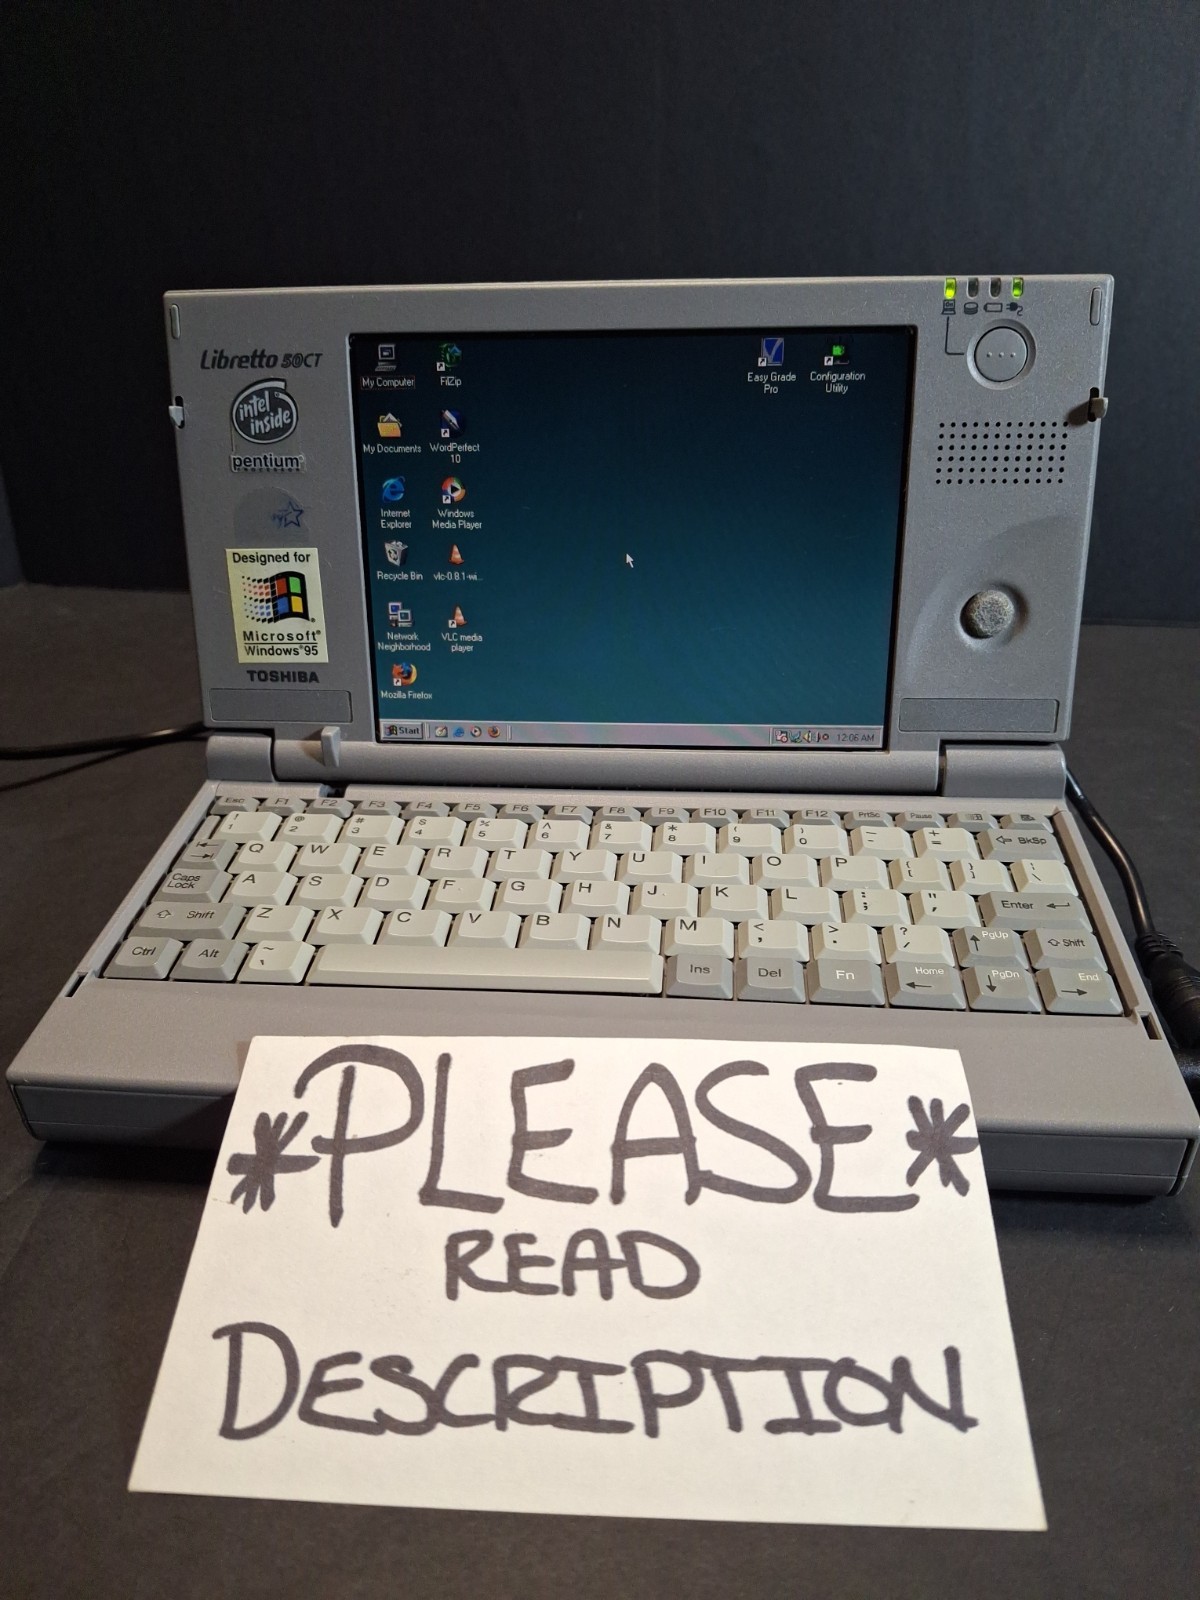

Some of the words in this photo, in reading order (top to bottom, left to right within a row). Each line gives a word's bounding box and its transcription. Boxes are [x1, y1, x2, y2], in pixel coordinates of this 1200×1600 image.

[201, 349, 278, 370] Libretto
[281, 353, 322, 368] 50CT
[748, 372, 768, 383] Easy
[771, 372, 796, 382] Grade
[810, 371, 866, 382] Configuration
[362, 378, 374, 388] My
[376, 377, 414, 388] Computer
[764, 384, 778, 394] Pro
[826, 383, 848, 394] Utility
[239, 390, 270, 422] intel
[250, 408, 291, 436] inside
[363, 444, 375, 454] My
[377, 444, 422, 453] Documents
[429, 443, 480, 452] WordPerfect
[232, 454, 299, 471] pentium
[450, 454, 461, 464] 10
[381, 509, 410, 517] Internet
[438, 508, 474, 517] Windows
[381, 520, 412, 530] Explorer
[432, 520, 456, 529] Media
[458, 520, 482, 530] Player
[232, 552, 290, 565] Designed
[294, 552, 310, 563] for
[377, 571, 409, 581] Recycle
[411, 571, 423, 580] Bin
[387, 632, 418, 640] Network
[441, 633, 458, 642] VLC
[460, 633, 483, 642] media
[378, 642, 431, 652] Neighborhood
[451, 644, 473, 653] player
[246, 670, 320, 683] TOSHIBA
[381, 690, 406, 699] Mozilla
[408, 690, 432, 699] Firefox
[399, 727, 419, 735] Start
[861, 734, 875, 742] AM
[1018, 837, 1047, 845] BkSp
[250, 844, 264, 853] Q
[311, 844, 329, 854] W
[373, 846, 386, 856] E
[438, 848, 451, 857] R
[504, 850, 516, 860] T
[570, 852, 582, 861] Y
[633, 853, 645, 862] U
[836, 858, 847, 867] P
[172, 873, 200, 882] Caps
[242, 874, 256, 884] A
[309, 876, 322, 886] S
[375, 877, 390, 887] D
[167, 881, 195, 889] Lock
[442, 880, 456, 889] F
[511, 881, 525, 892] G
[579, 883, 592, 893] H
[648, 885, 657, 895] J
[716, 886, 729, 897] K
[786, 889, 798, 900] L
[1001, 901, 1034, 910] Enter
[187, 910, 215, 919] Shift
[257, 907, 273, 918] Z
[327, 909, 343, 920] X
[397, 912, 412, 923] C
[469, 913, 482, 924] V
[536, 915, 550, 926] B
[608, 917, 621, 928] N
[680, 920, 697, 931] M
[754, 923, 764, 931] <
[828, 925, 839, 933] >
[900, 926, 908, 936] ?
[982, 931, 1009, 940] PgUp
[1062, 939, 1085, 947] Shift
[132, 947, 156, 956] Ctrl
[198, 949, 219, 958] Alt
[690, 964, 710, 974] Ins
[758, 968, 782, 977] Del
[915, 967, 944, 975] Home
[836, 970, 855, 980] Fn
[992, 970, 1020, 979] PgDn
[1079, 973, 1099, 981] End
[444, 1228, 702, 1301] READ
[212, 1320, 979, 1440] DESCRIPTION
